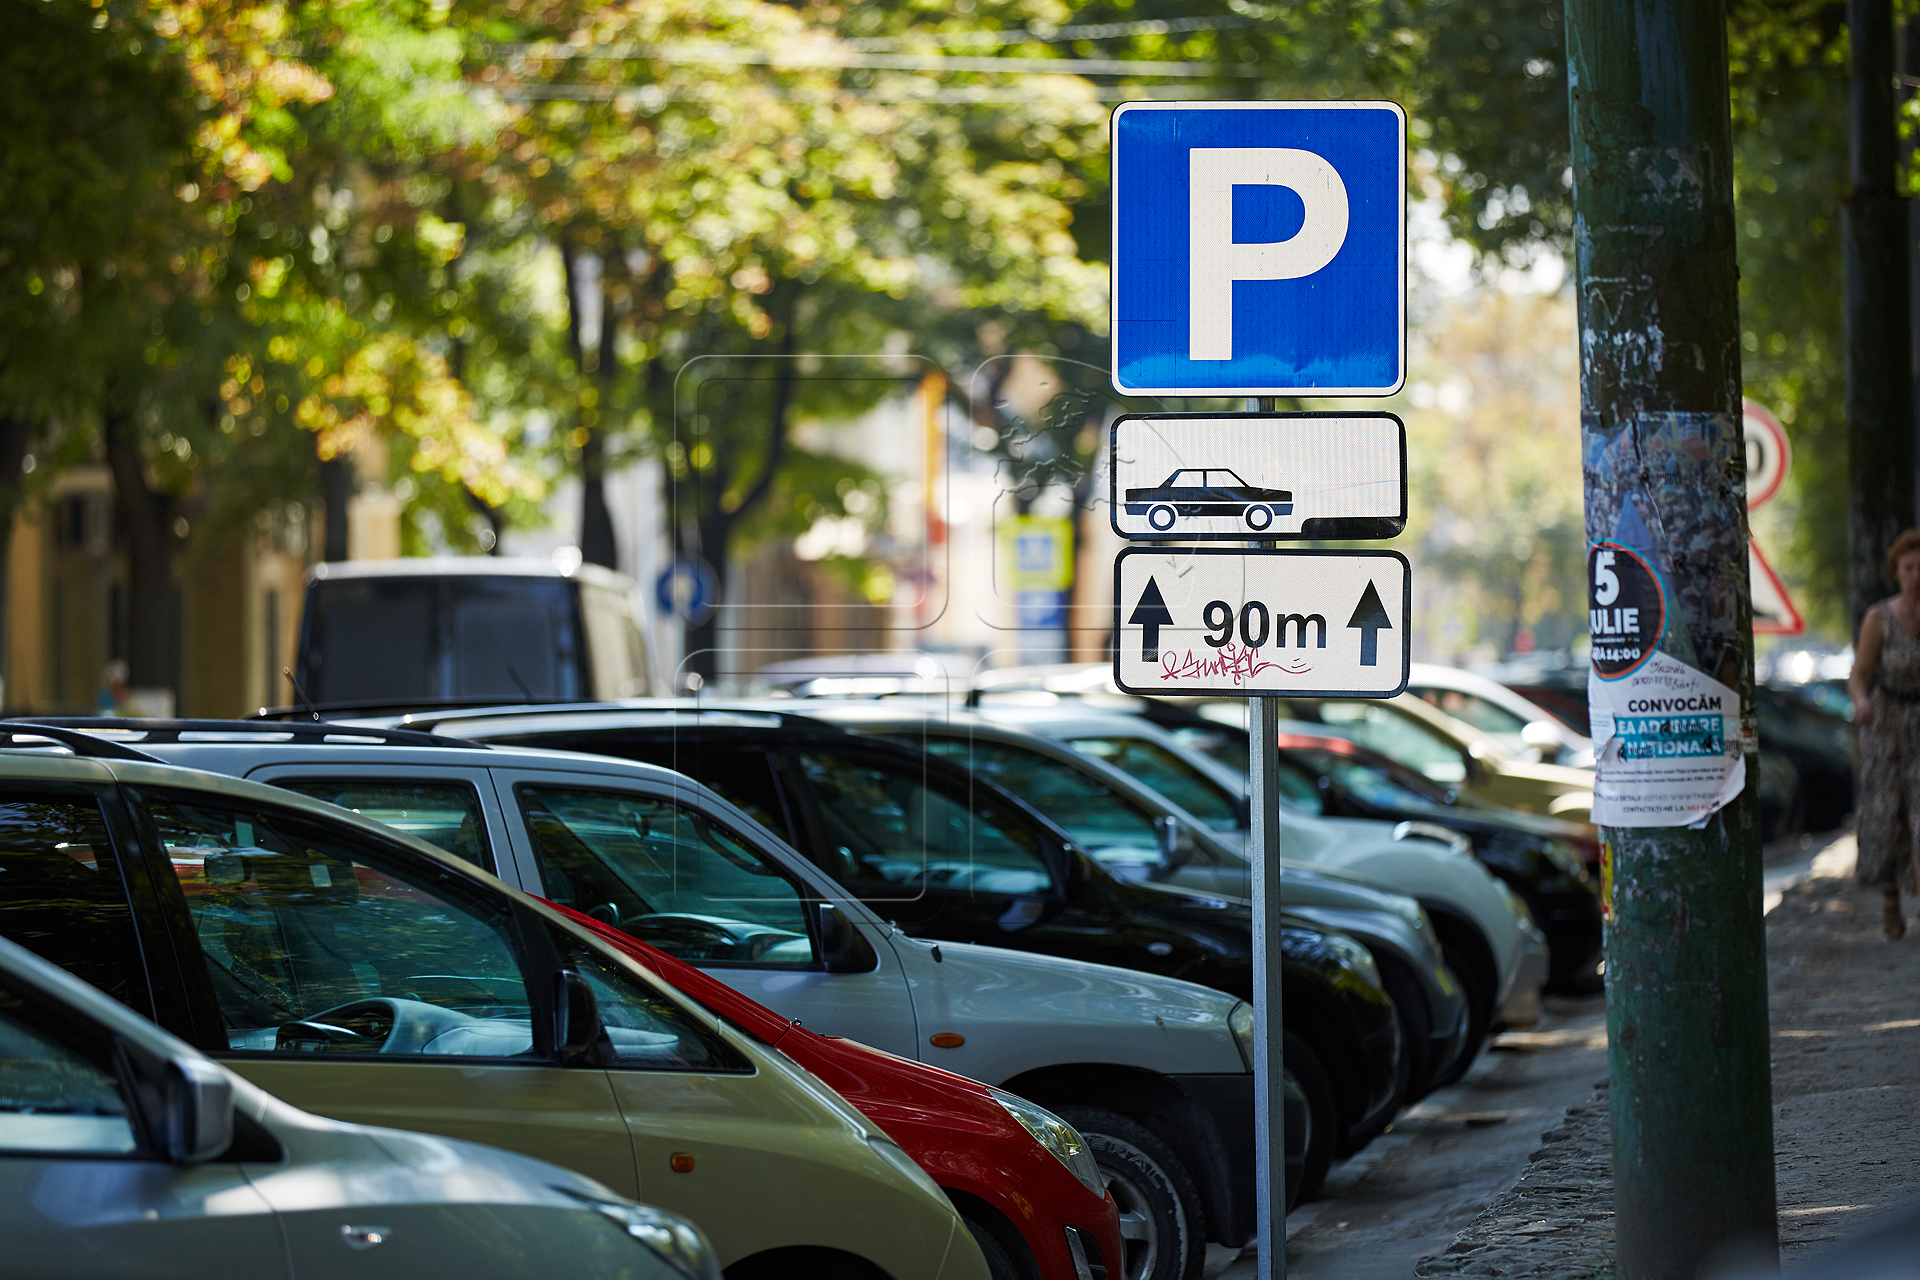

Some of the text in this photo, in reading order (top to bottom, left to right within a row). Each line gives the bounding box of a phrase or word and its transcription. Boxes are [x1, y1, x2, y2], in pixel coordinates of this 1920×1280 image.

[1190, 148, 1349, 360] P
[1594, 551, 1620, 606] 5
[1203, 600, 1327, 649] 90m
[1605, 647, 1641, 662] 14:00
[1628, 694, 1722, 713] CONVOCĂM
